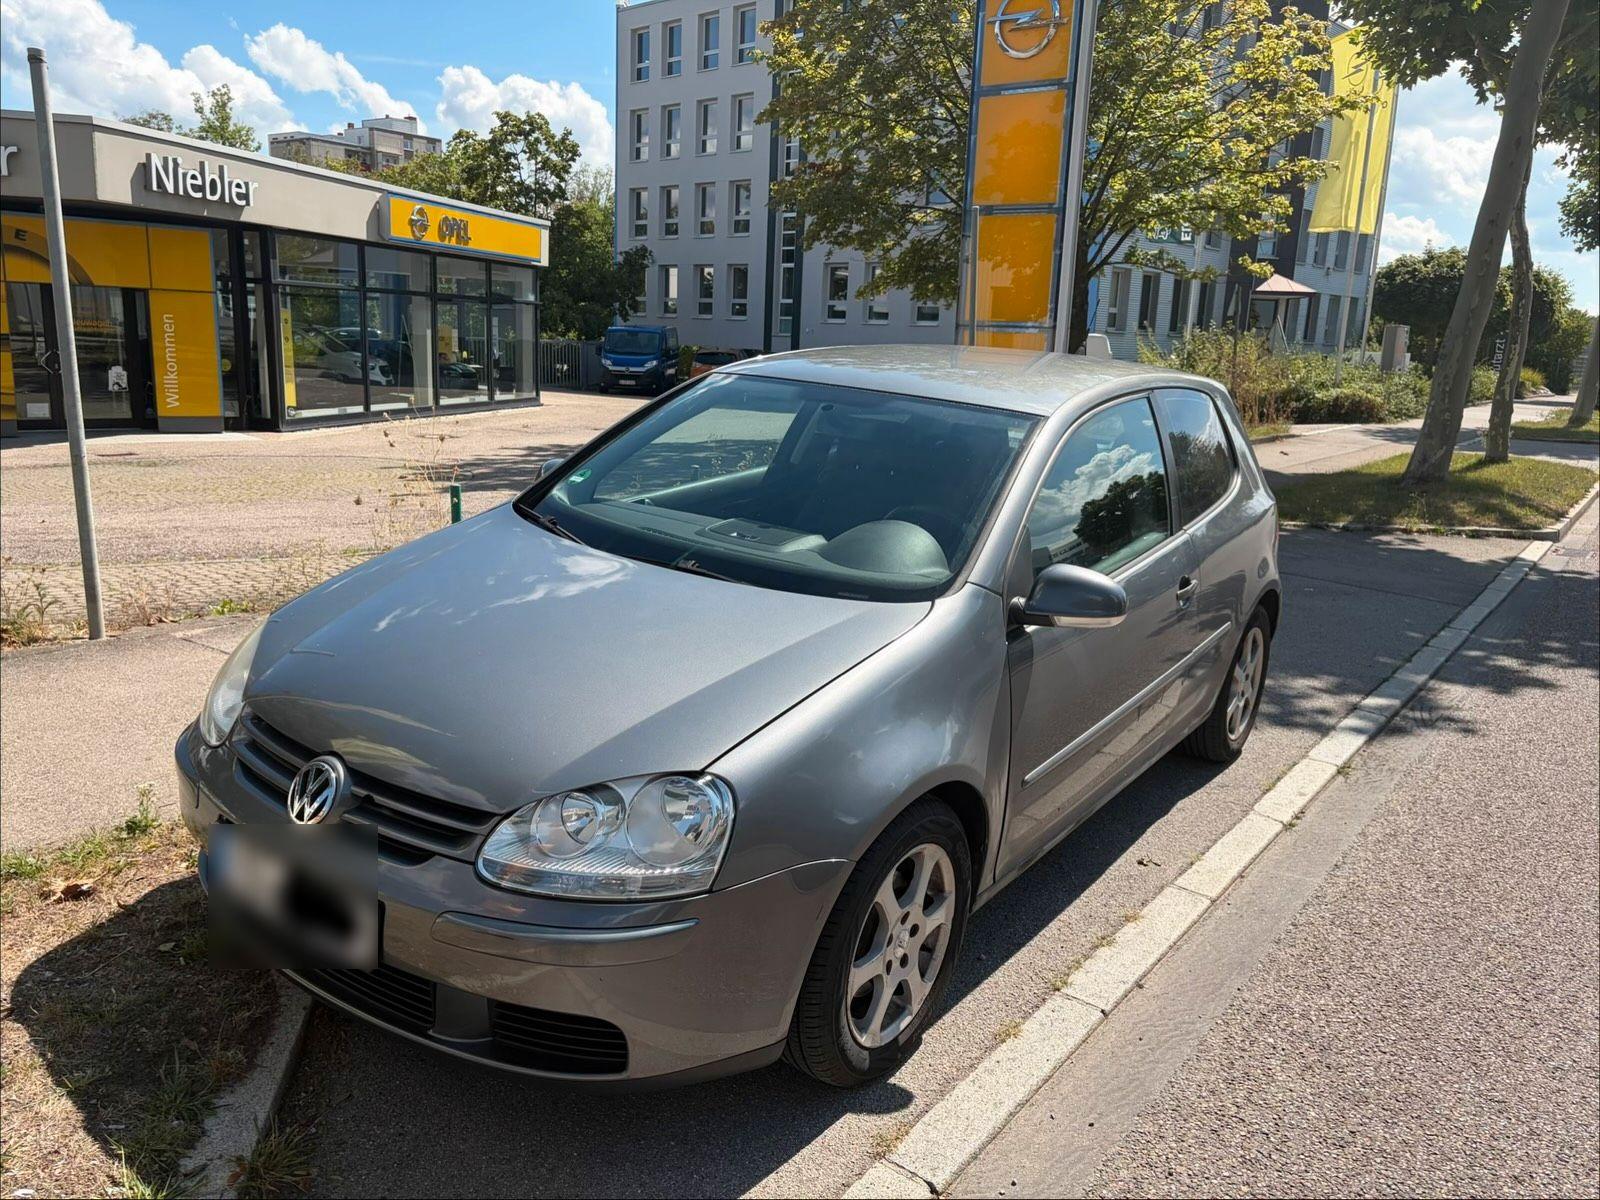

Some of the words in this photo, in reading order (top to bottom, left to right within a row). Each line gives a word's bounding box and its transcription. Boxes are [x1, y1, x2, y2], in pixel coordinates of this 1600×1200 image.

[149, 152, 259, 207] Niebler
[438, 215, 471, 243] OPEL
[163, 313, 180, 408] Willkommen
